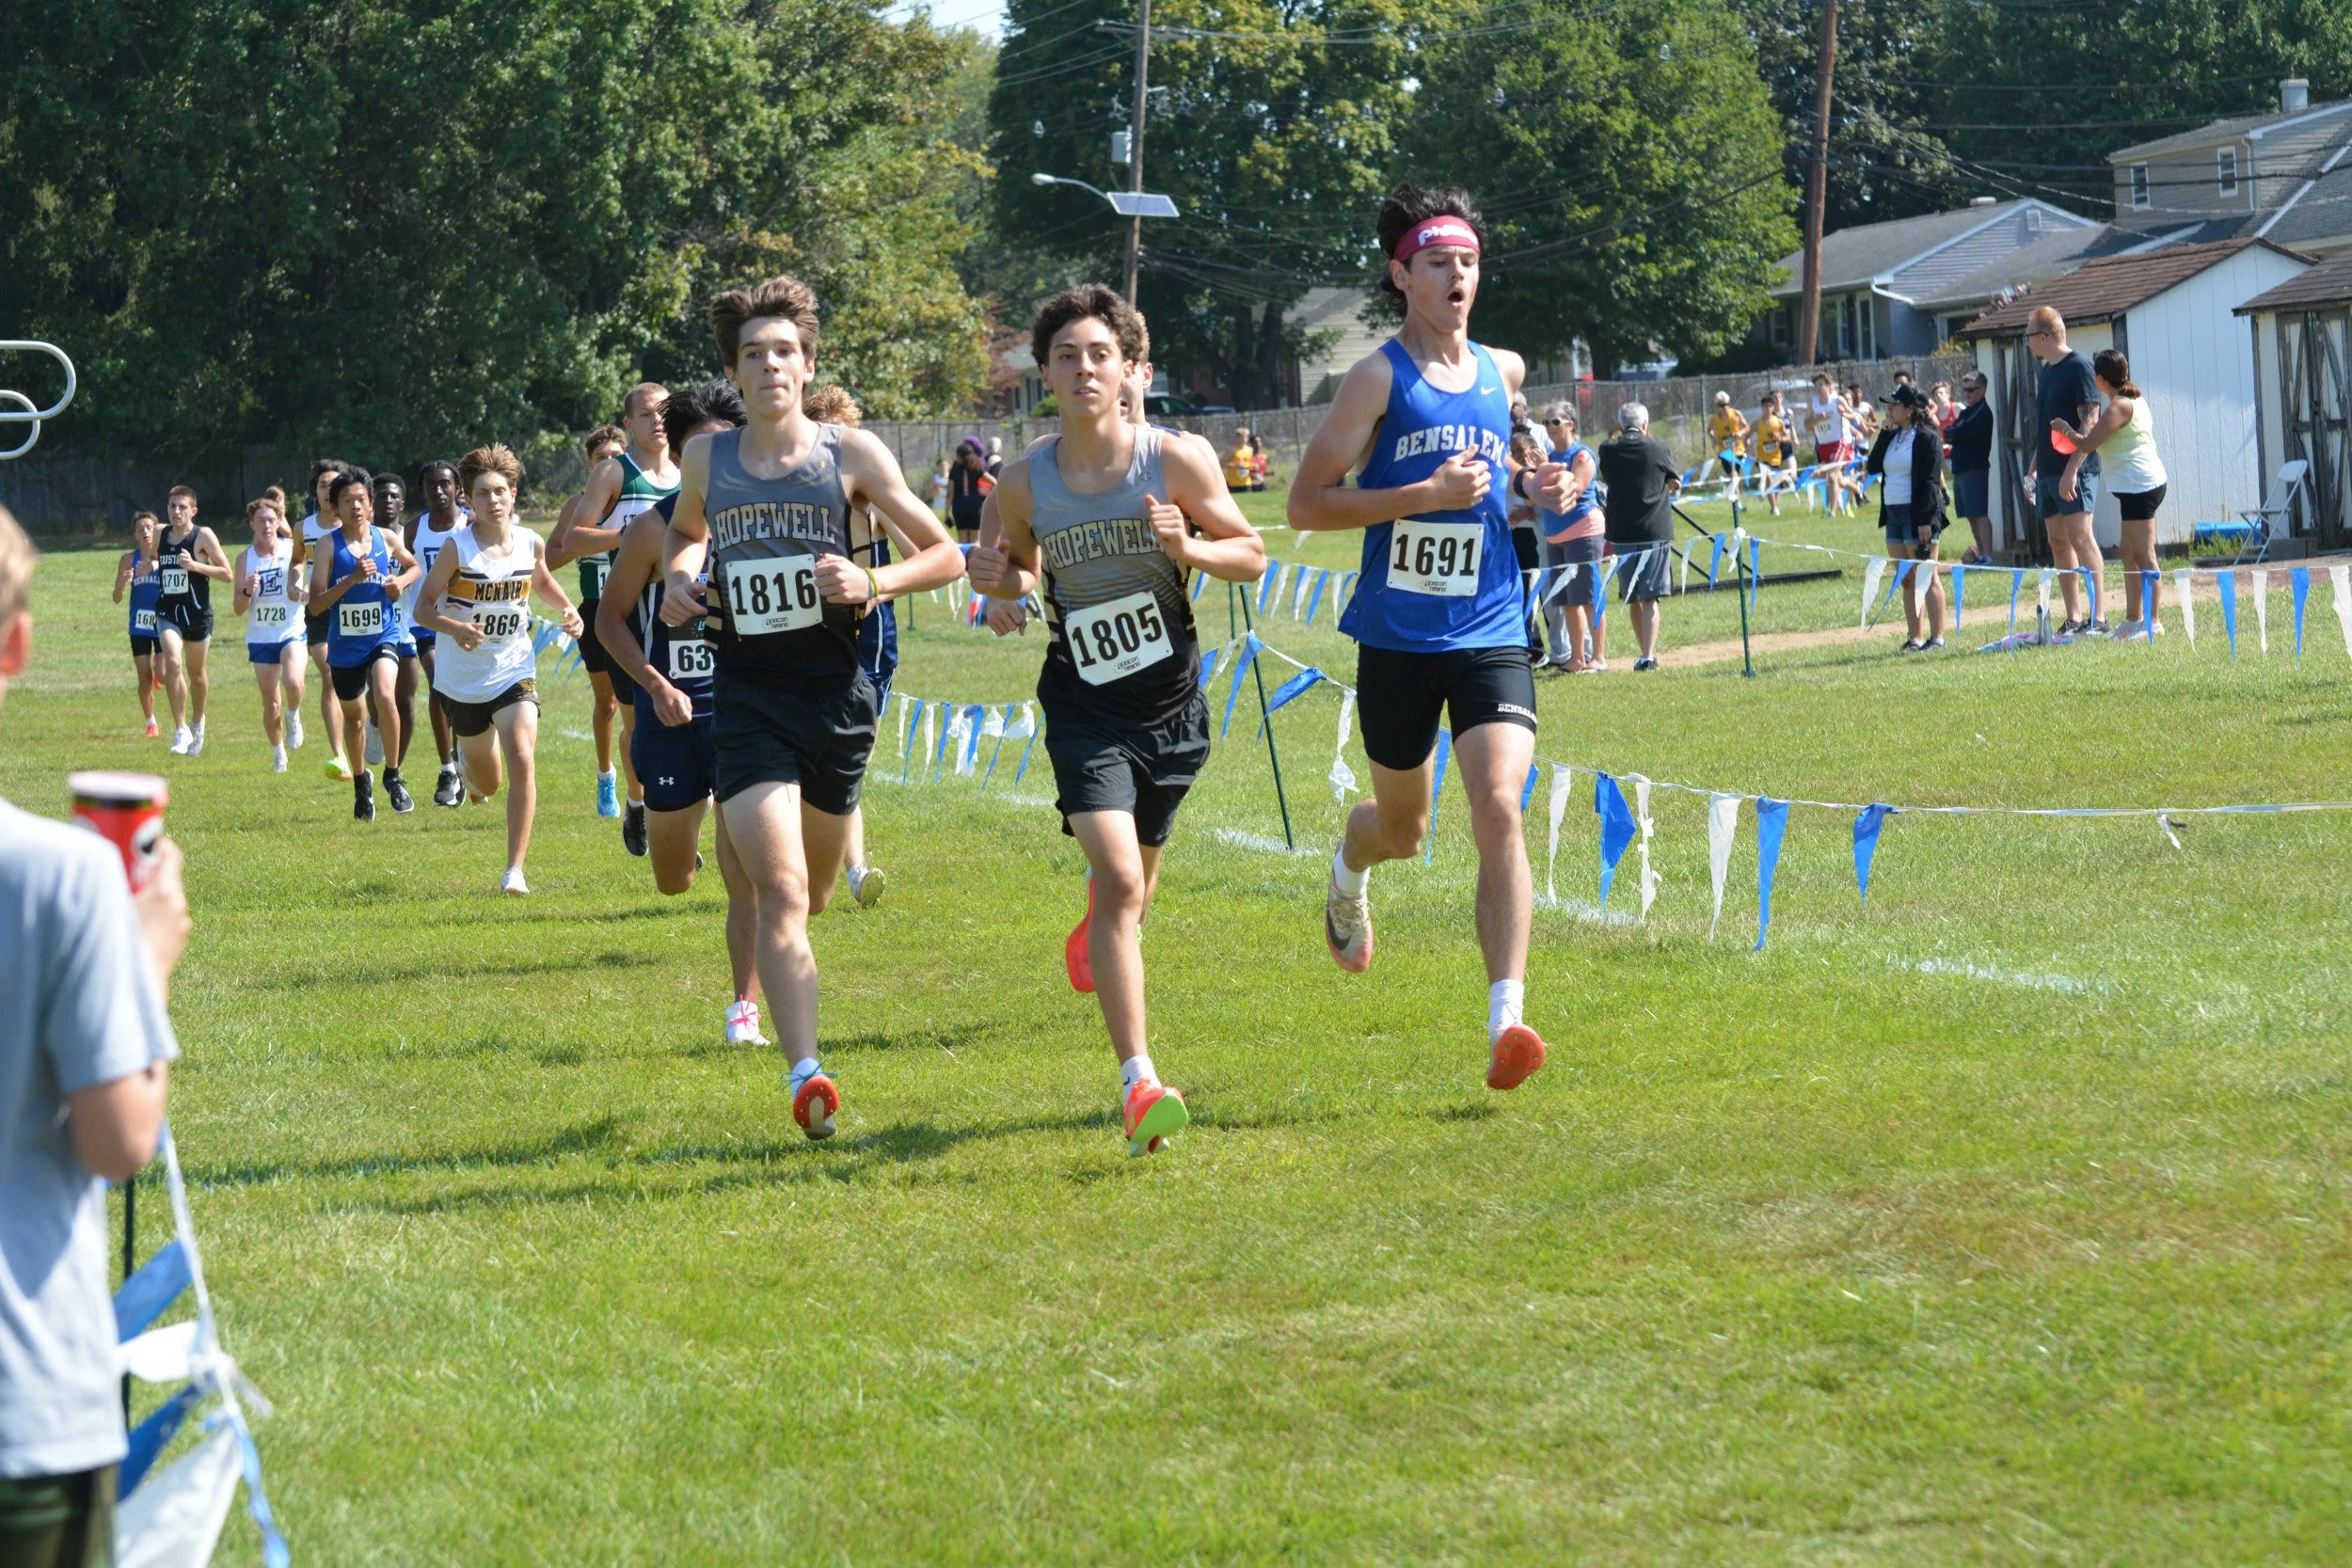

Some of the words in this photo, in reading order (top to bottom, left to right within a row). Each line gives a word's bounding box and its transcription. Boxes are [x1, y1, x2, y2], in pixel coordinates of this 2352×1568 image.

[1393, 424, 1505, 468] BENSALEM
[715, 502, 837, 551] HOPEWELL
[1393, 533, 1475, 577] 1691
[164, 573, 187, 588] 1707
[731, 568, 817, 616] 1816
[256, 607, 286, 622] 1728
[341, 608, 381, 627] 1699
[473, 613, 520, 636] 1869
[1072, 603, 1163, 668] 1805
